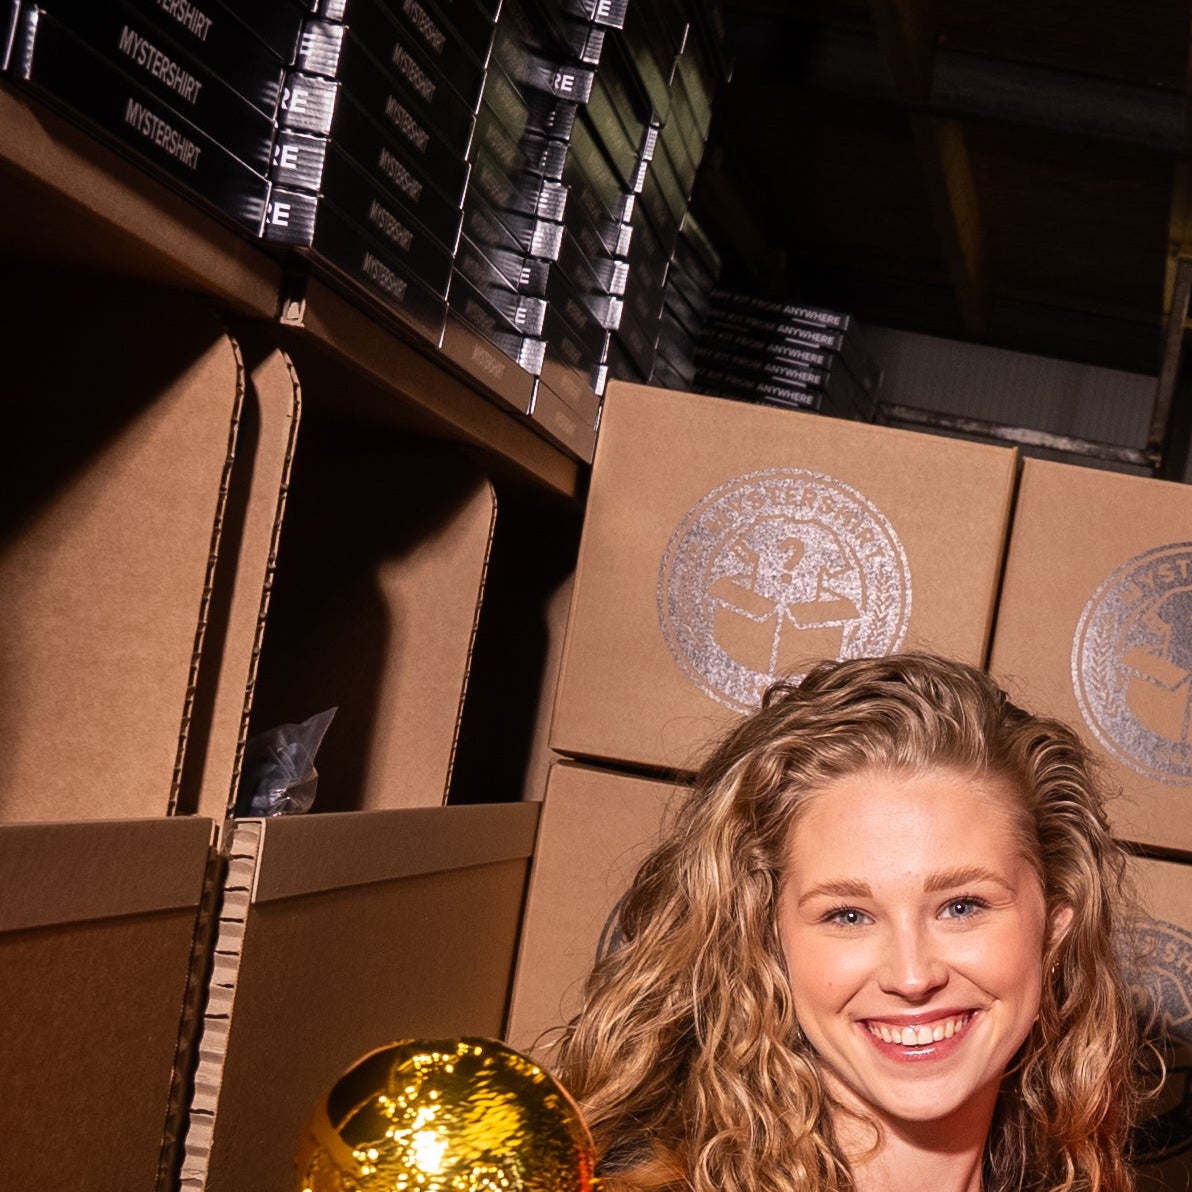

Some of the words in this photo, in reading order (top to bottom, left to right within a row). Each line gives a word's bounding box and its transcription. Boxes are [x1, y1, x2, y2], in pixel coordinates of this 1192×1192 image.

[156, 0, 214, 42] ERSHIRT
[117, 24, 203, 104] MYSTERSHIRT
[125, 97, 202, 170] MYSTERSHIRT
[783, 305, 842, 326] ANYWHERE
[776, 324, 835, 345] ANYWHERE
[767, 344, 825, 365] ANYWHERE
[764, 363, 822, 385] ANYWHERE
[756, 383, 814, 405] ANYWHERE
